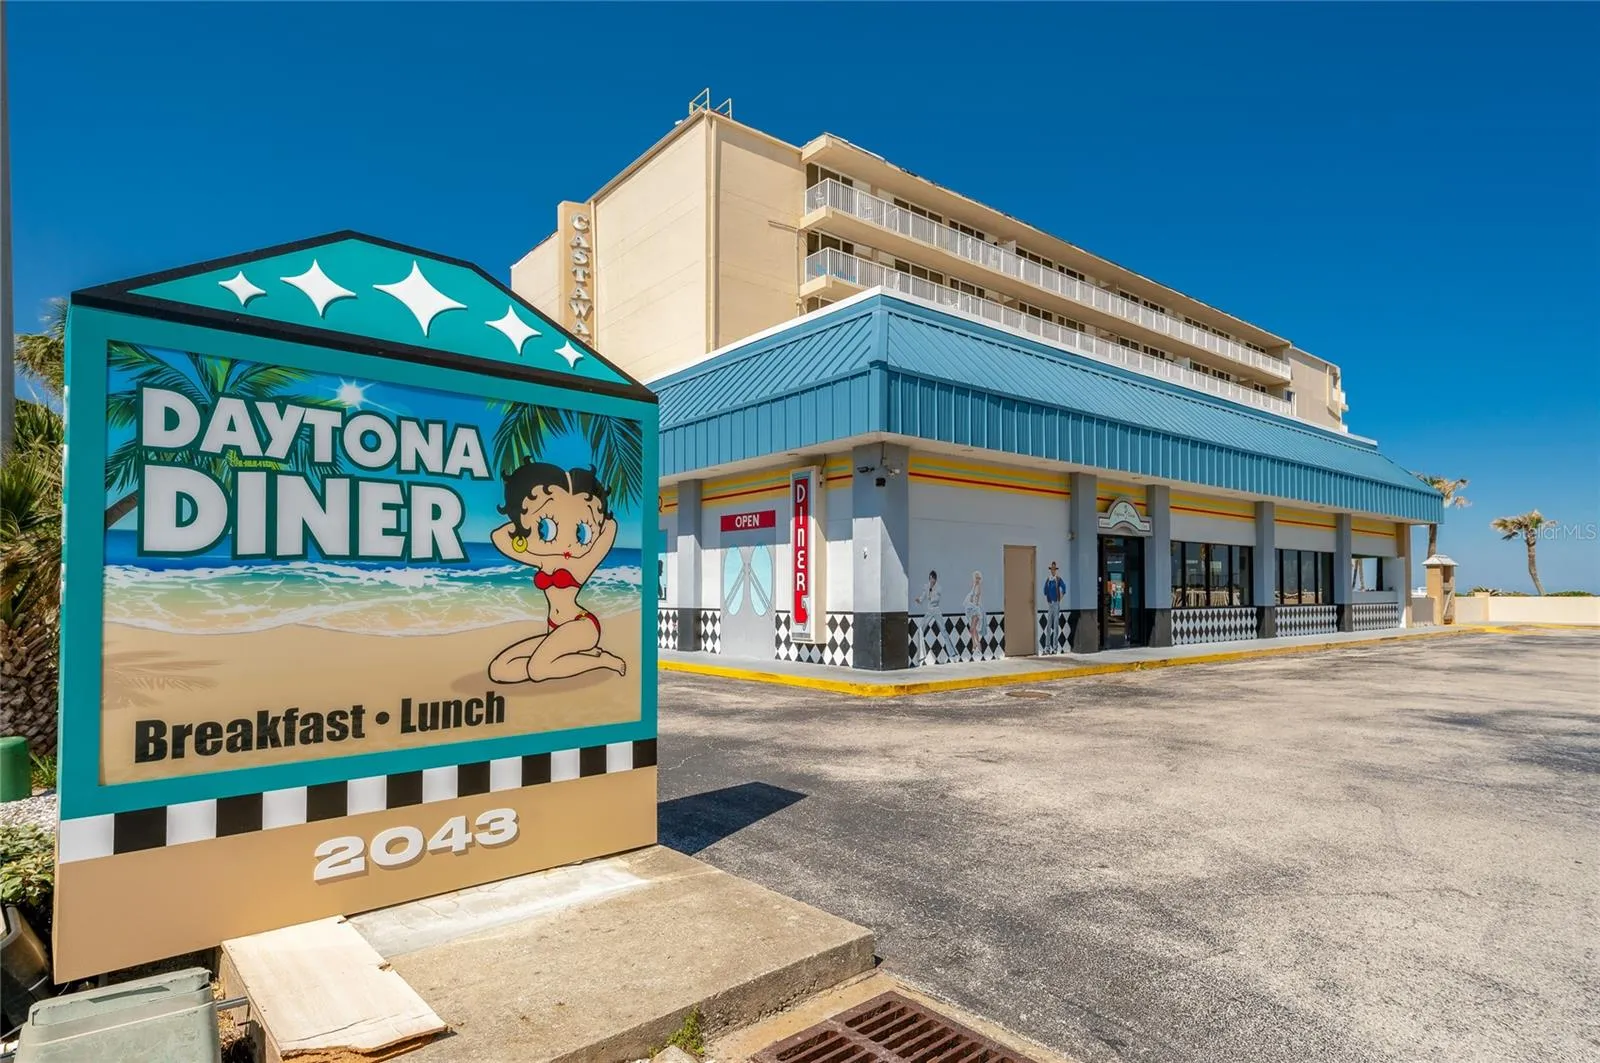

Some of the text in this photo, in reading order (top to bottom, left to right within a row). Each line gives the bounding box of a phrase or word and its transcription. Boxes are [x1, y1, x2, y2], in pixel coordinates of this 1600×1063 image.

[570, 213, 592, 343] CASTAWA
[142, 386, 490, 478] DAYTONA
[143, 464, 465, 560] DINER
[735, 514, 760, 528] OPEN
[796, 484, 806, 591] DINER
[135, 691, 506, 763] Breakfast Lunch
[314, 808, 517, 881] 2043
